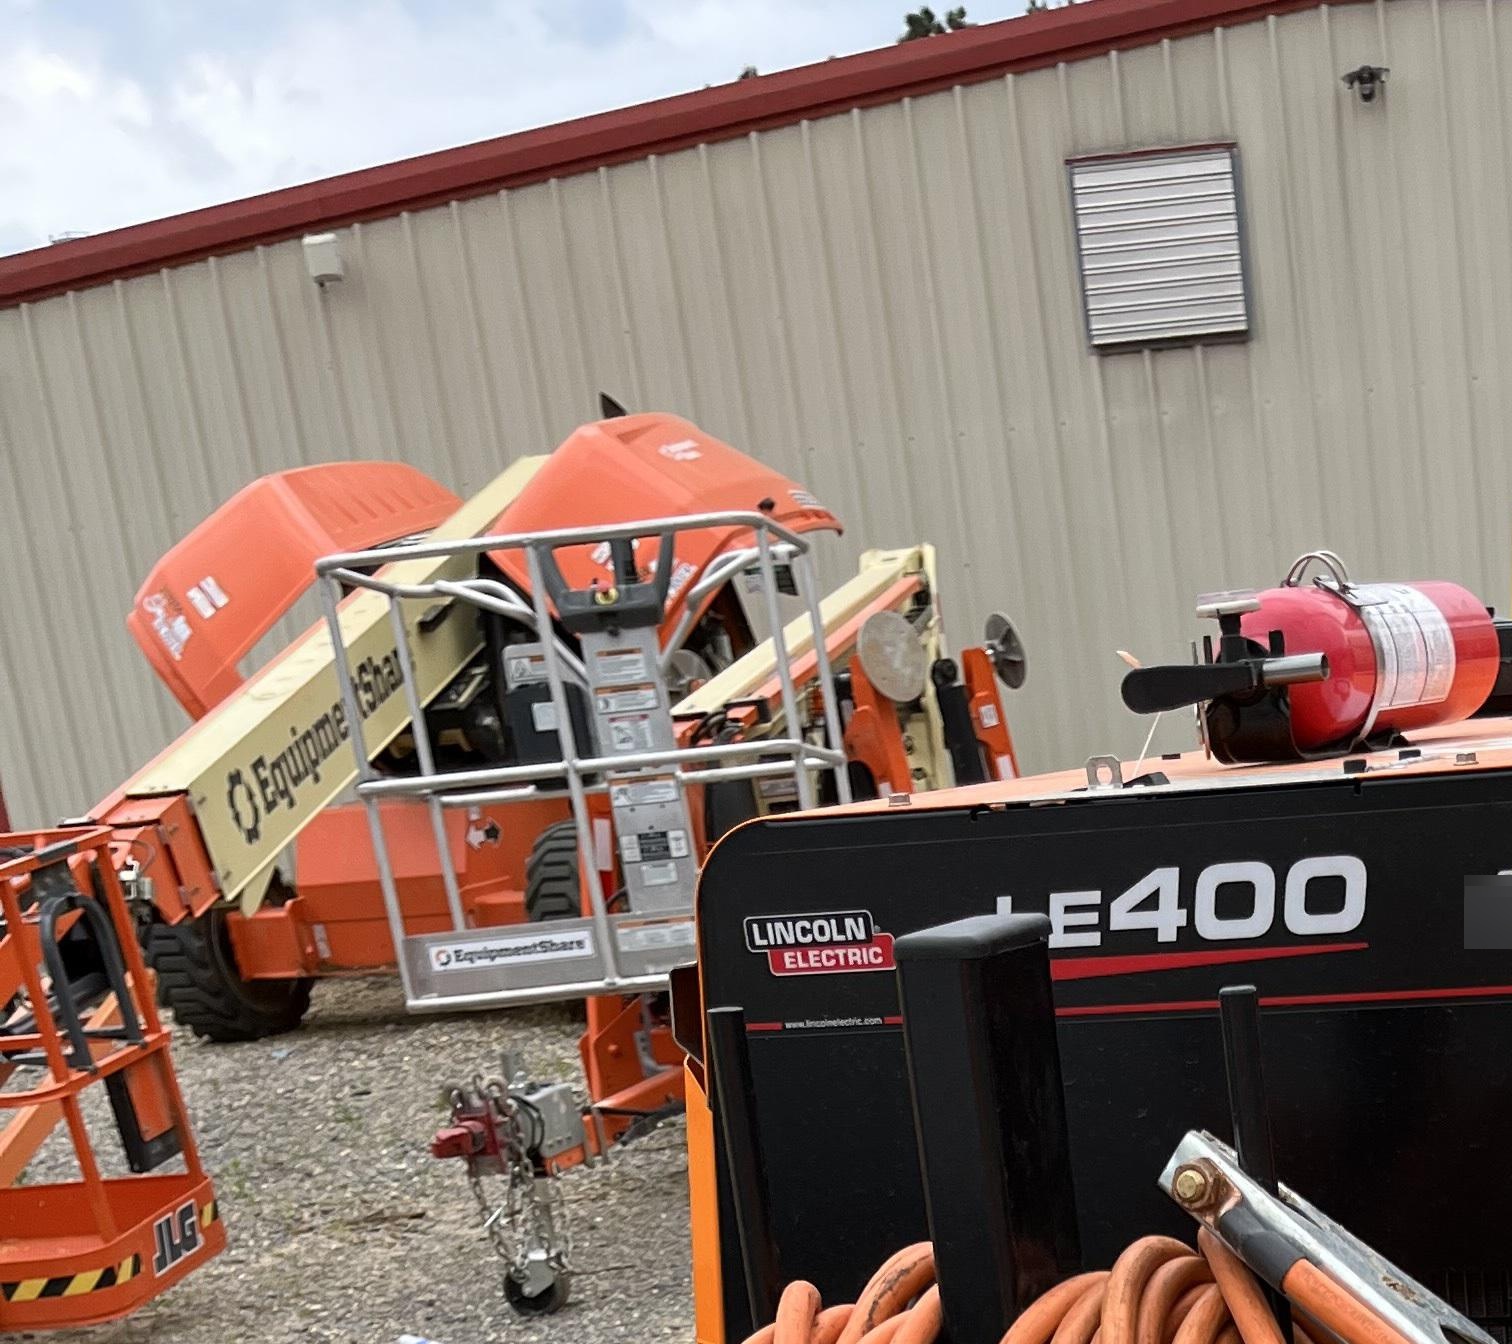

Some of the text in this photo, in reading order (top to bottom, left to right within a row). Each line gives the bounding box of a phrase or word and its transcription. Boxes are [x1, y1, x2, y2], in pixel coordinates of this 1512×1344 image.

[752, 917, 867, 946] LINCOLN
[454, 938, 585, 964] EquipmentShare
[783, 947, 884, 969] ELECTRIC
[785, 1016, 883, 1029] www.lincolnelectric.com
[152, 1199, 204, 1278] JLG
